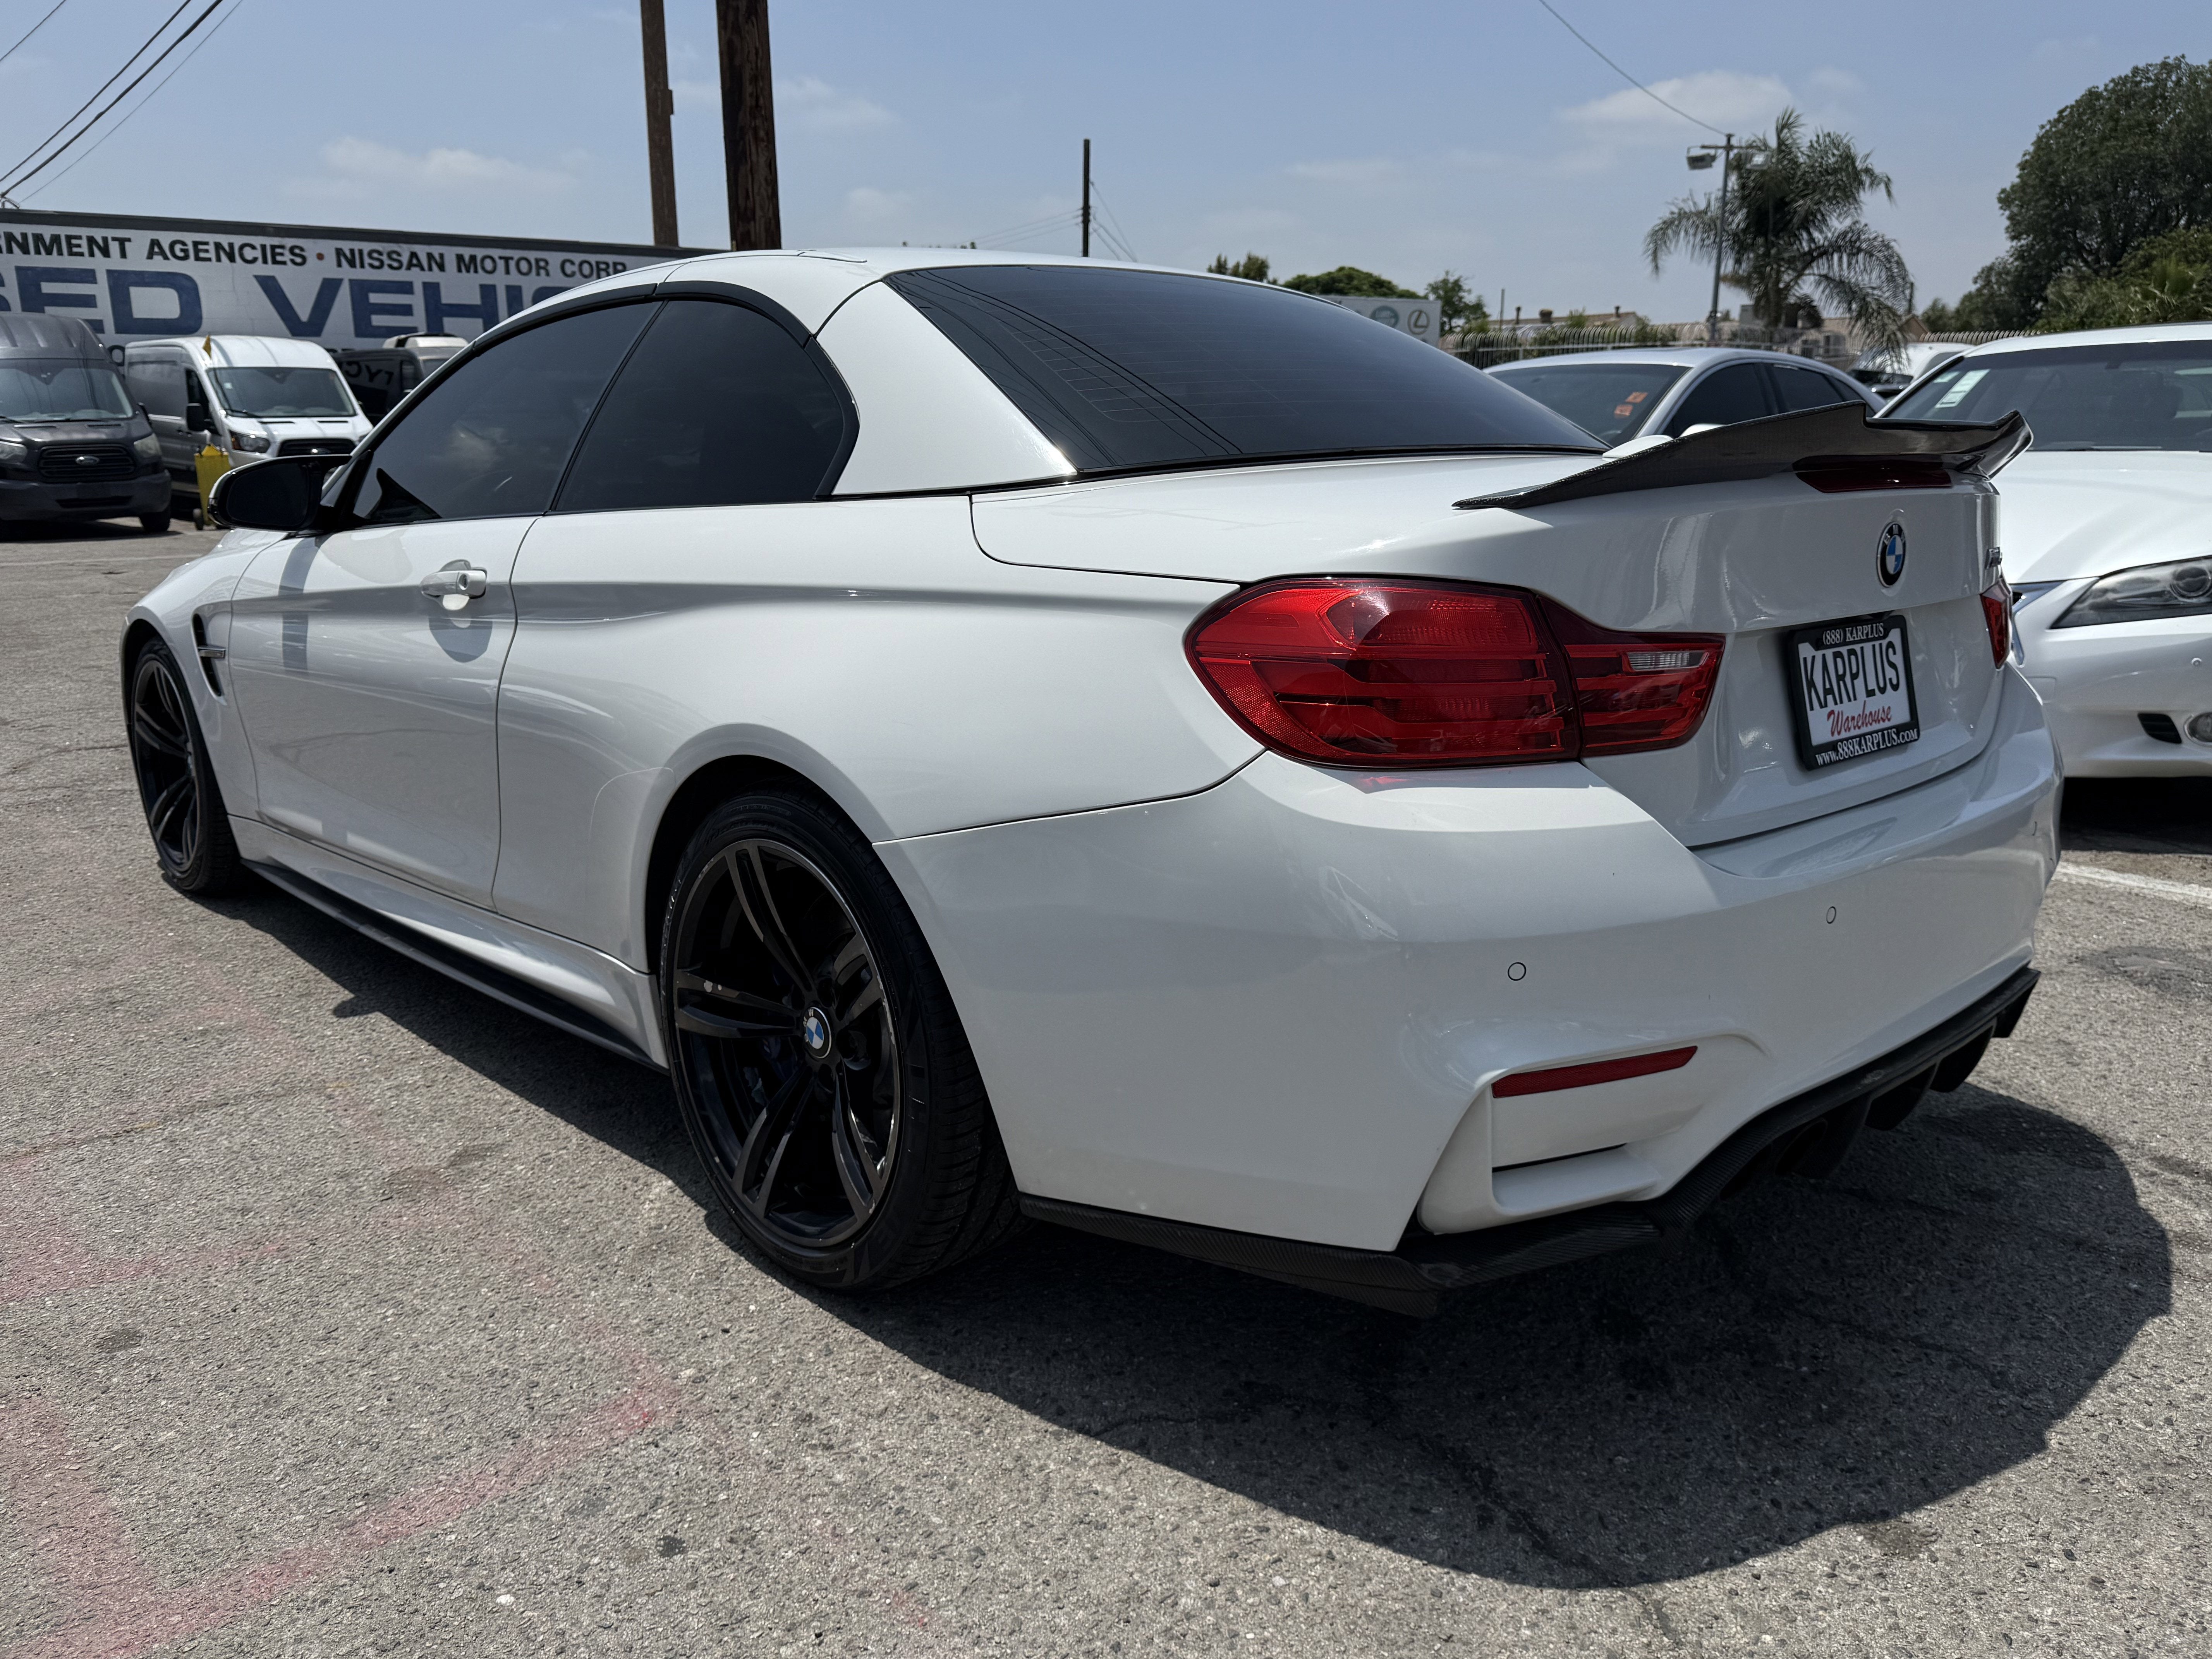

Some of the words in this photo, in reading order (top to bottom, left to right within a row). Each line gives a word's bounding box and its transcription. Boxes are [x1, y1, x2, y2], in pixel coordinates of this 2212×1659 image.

[0, 231, 132, 259] NMENT
[146, 238, 307, 266] AGENCIES
[335, 247, 445, 273] NISSAN
[456, 253, 550, 277] MOTOR
[560, 258, 627, 279] CORP
[0, 266, 203, 335] ED
[253, 275, 573, 338] VEHI
[1822, 629, 1844, 645] (888)
[1845, 623, 1884, 642] KARPLUS
[1803, 641, 1900, 711] KARPLUS
[1827, 700, 1892, 737] Warehouse
